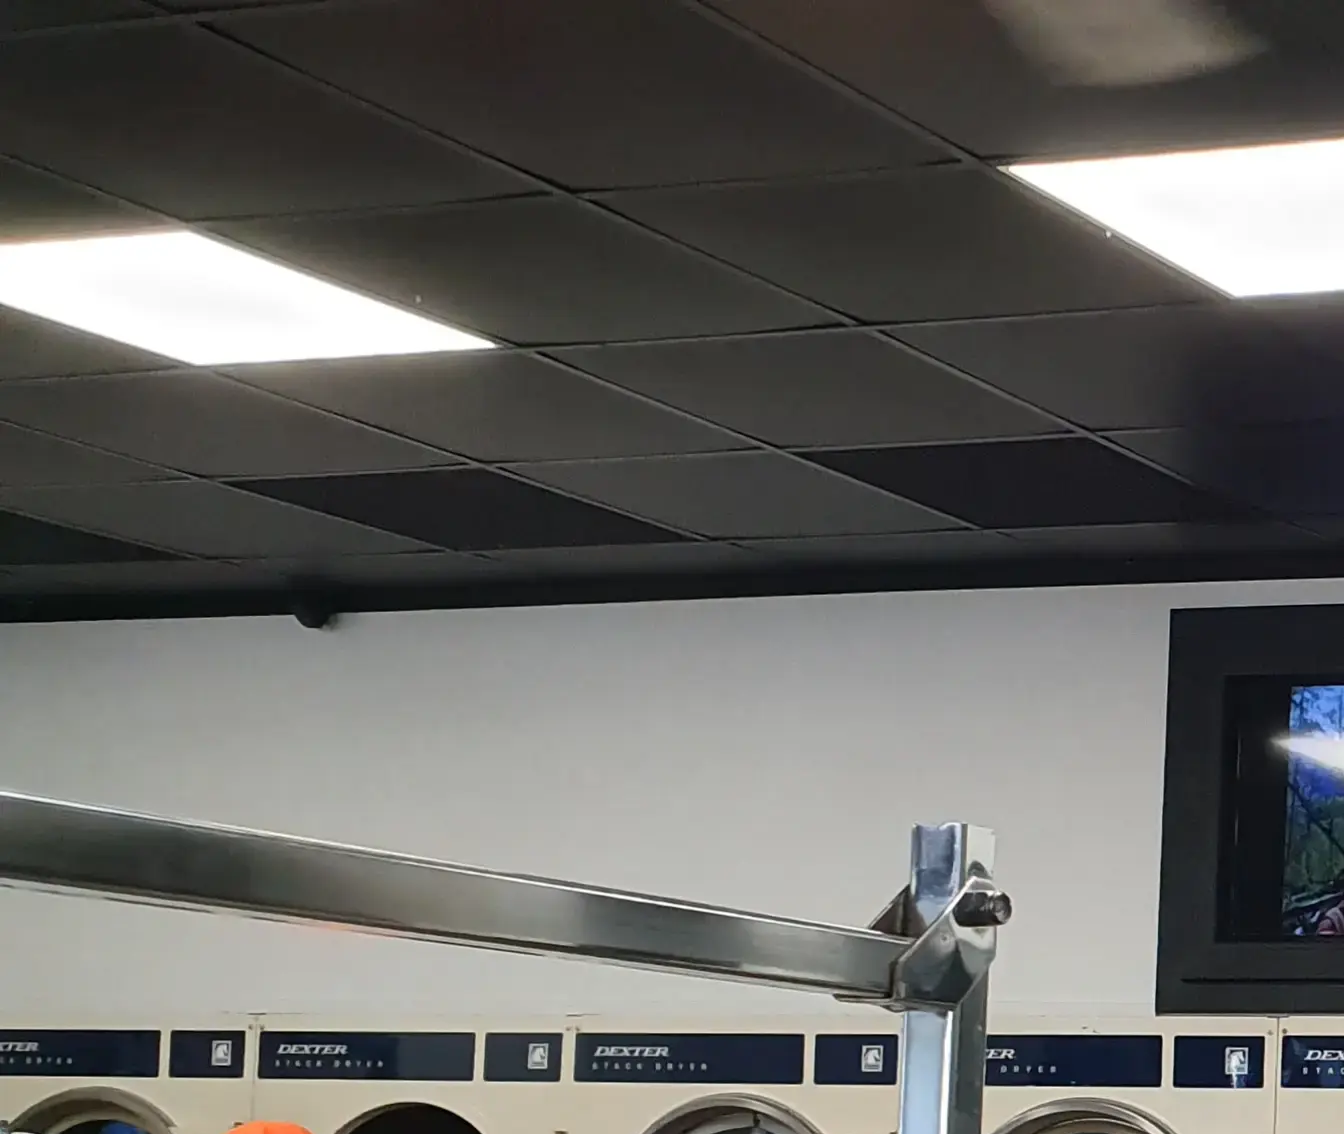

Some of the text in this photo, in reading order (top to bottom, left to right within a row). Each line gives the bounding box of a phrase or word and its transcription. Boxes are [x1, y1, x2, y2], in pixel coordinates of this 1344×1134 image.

[0, 1042, 39, 1052] TER
[277, 1044, 349, 1055] DEXTER
[593, 1046, 670, 1057] DEXTER
